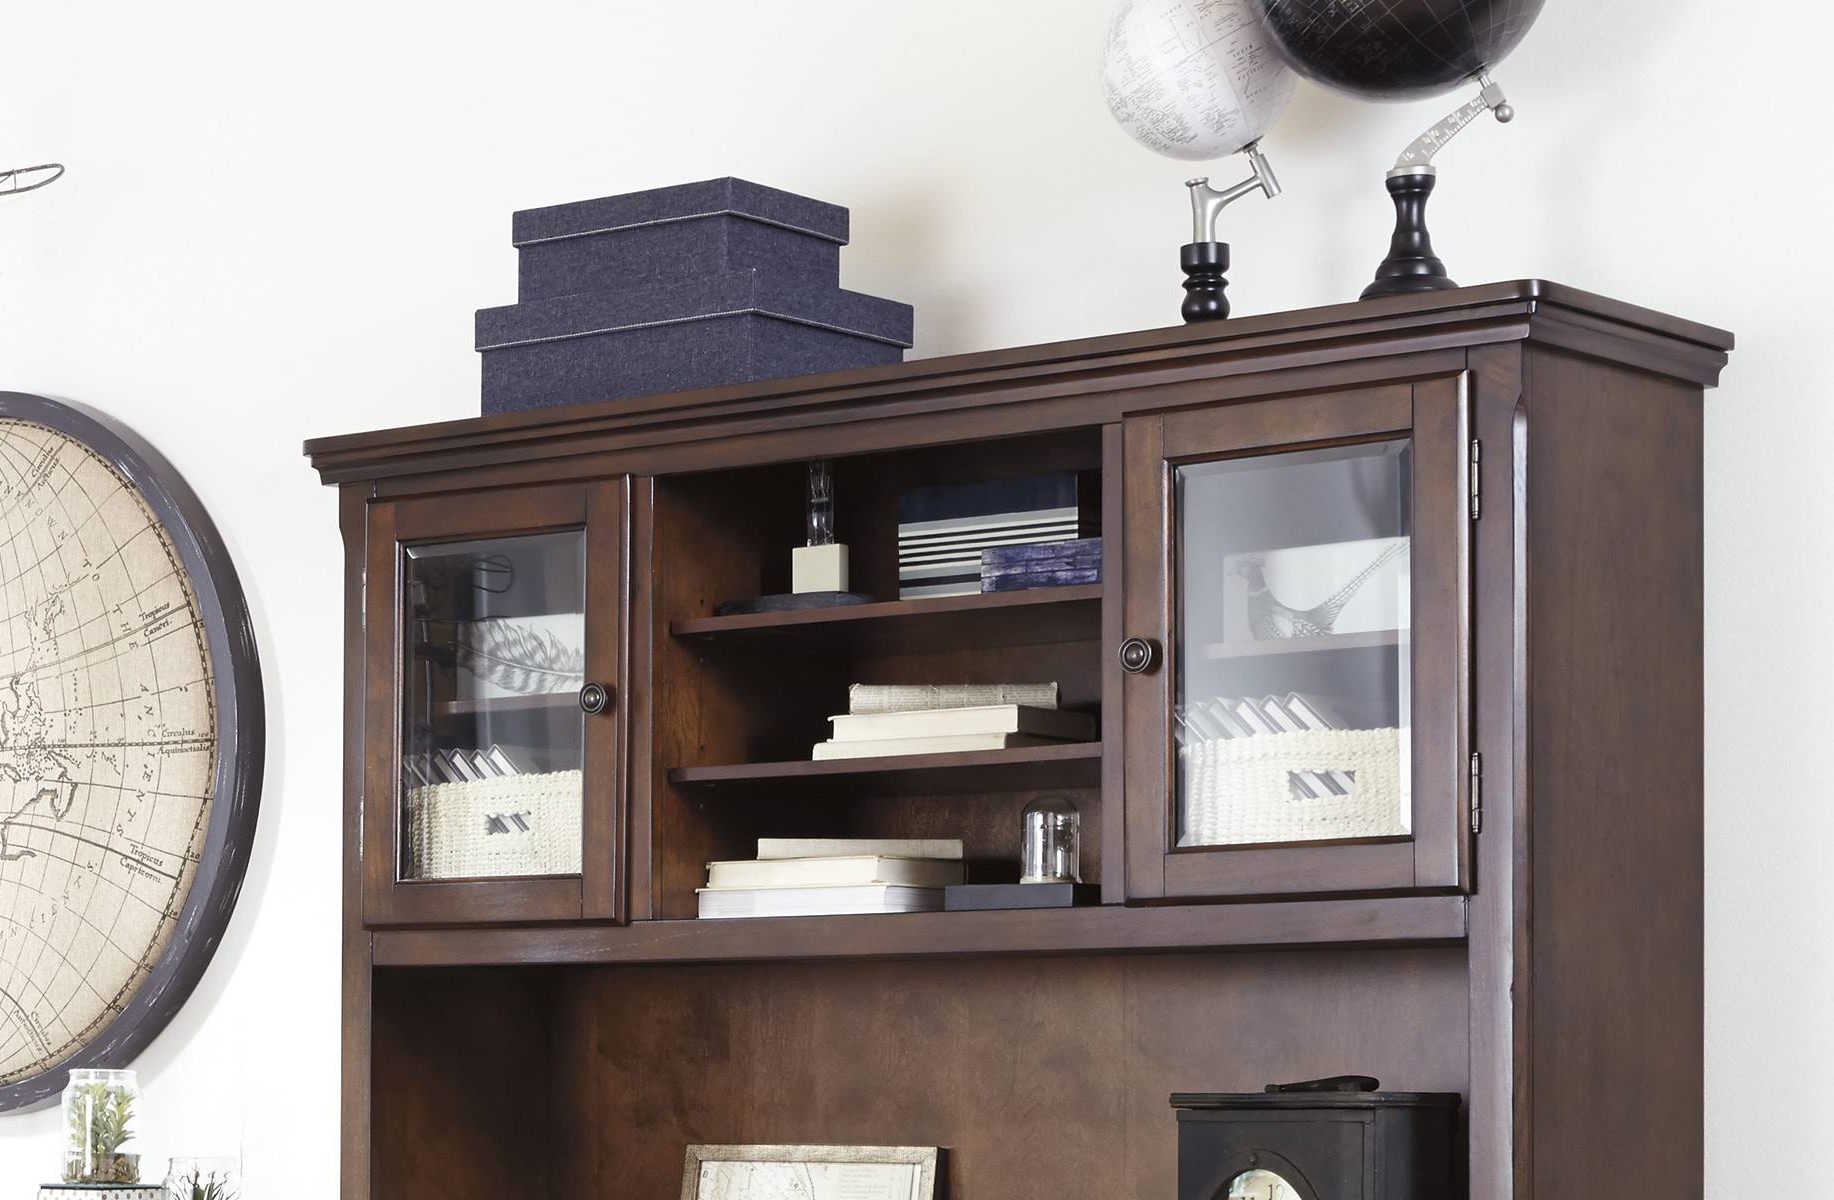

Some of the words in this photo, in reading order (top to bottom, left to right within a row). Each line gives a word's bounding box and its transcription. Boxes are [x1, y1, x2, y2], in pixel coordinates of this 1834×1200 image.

[138, 601, 170, 622] Tropicus
[161, 727, 196, 738] Circulus
[129, 844, 165, 868] Tropicus
